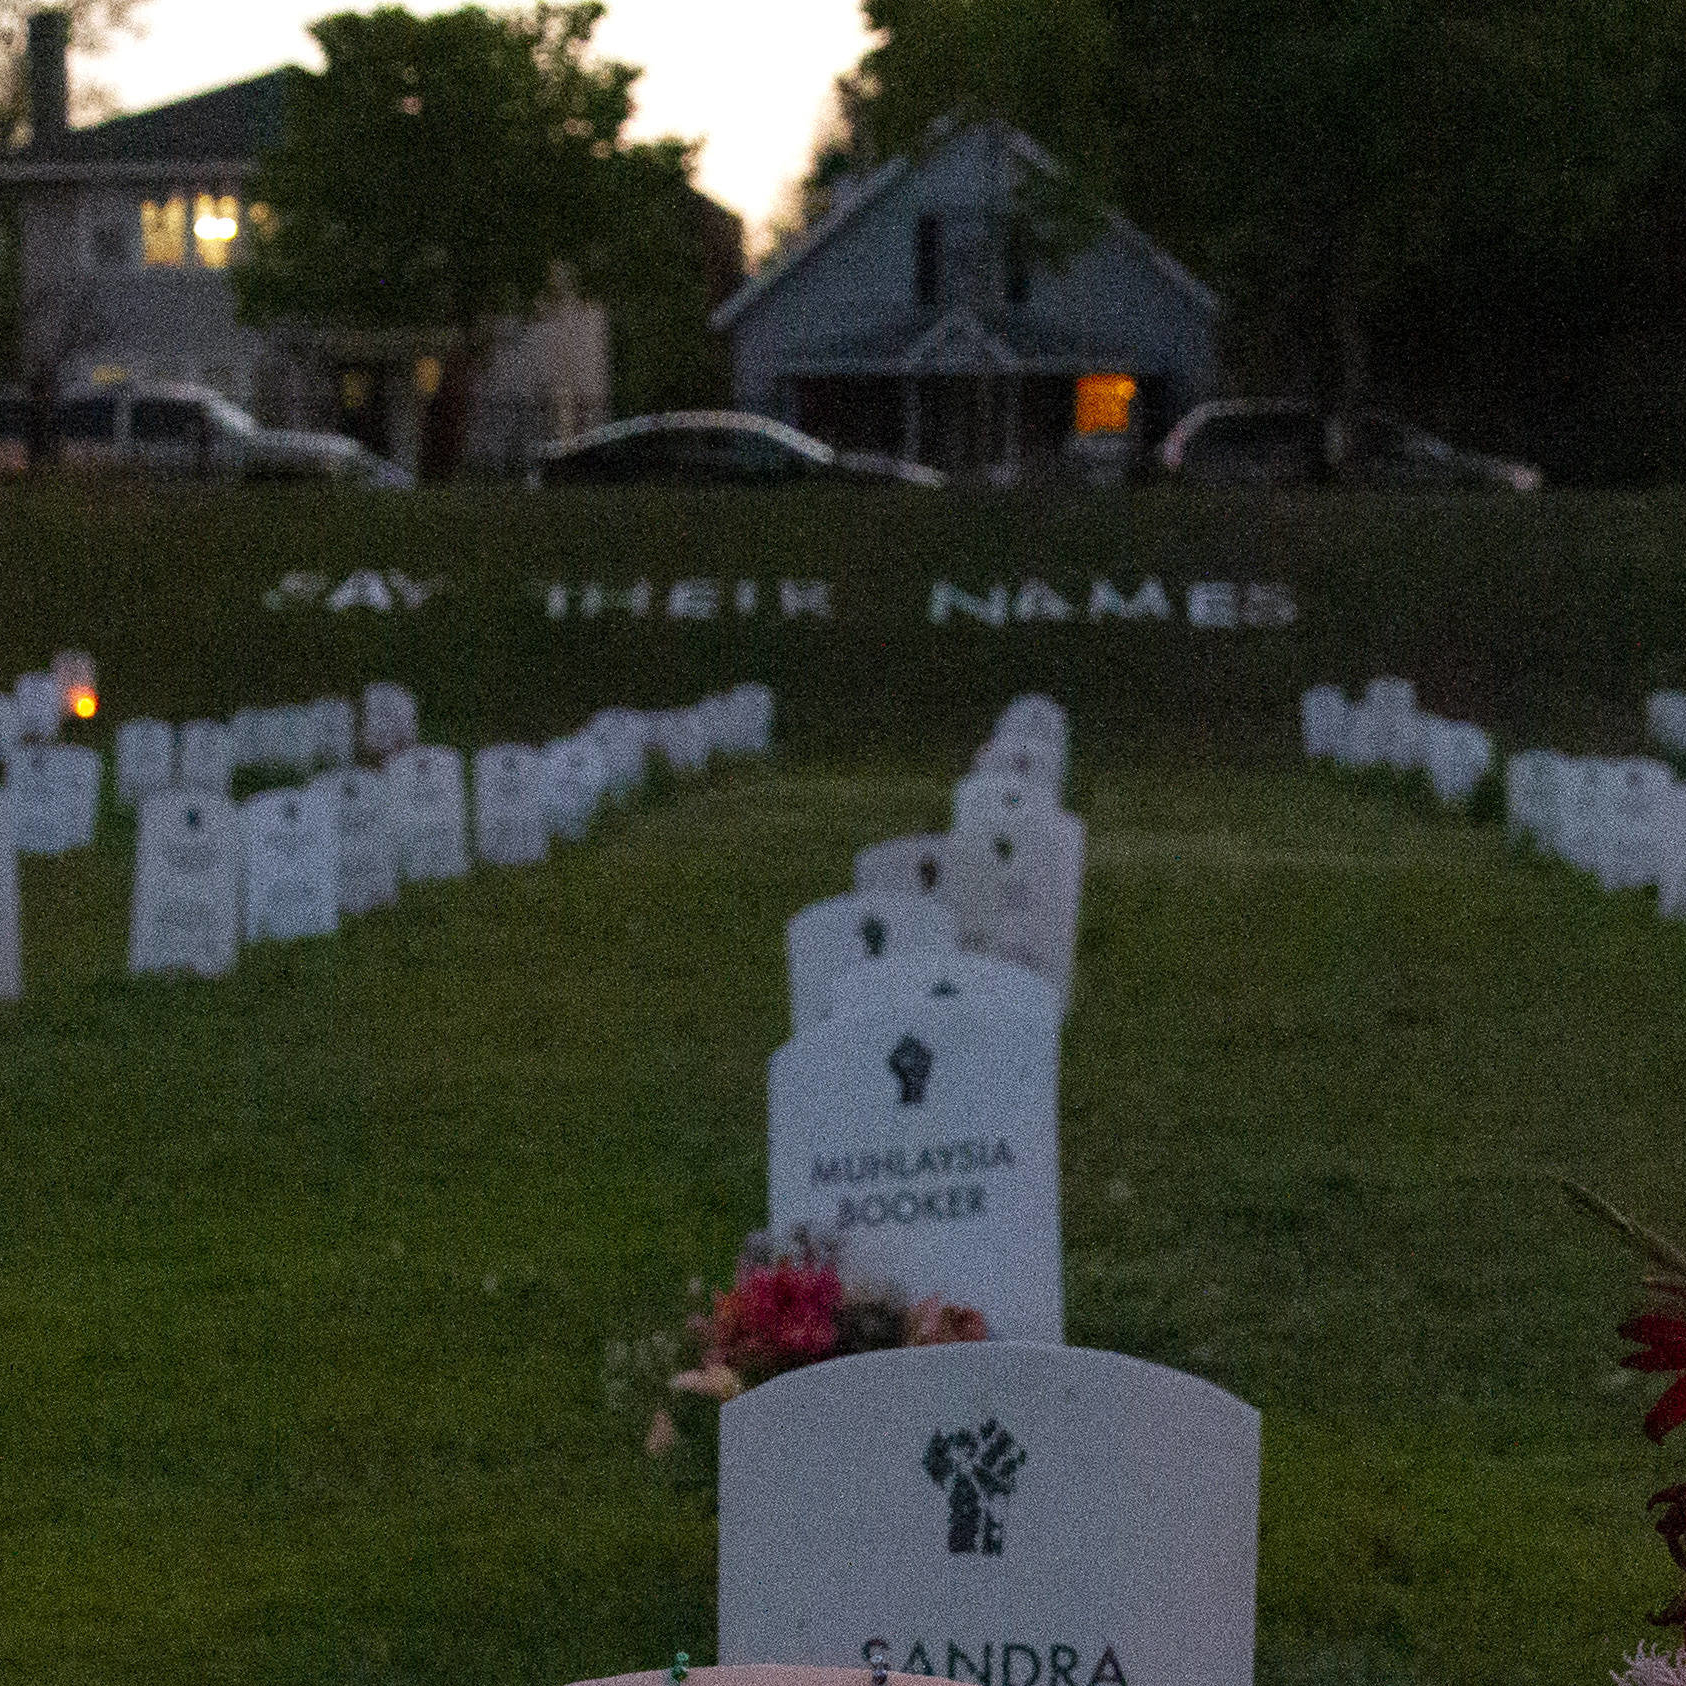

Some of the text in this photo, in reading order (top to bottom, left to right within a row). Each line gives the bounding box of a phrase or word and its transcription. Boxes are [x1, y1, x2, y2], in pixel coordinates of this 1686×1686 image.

[926, 574, 1299, 628] NAMES
[811, 1138, 1016, 1186] MUHLAYSIA
[836, 1186, 986, 1230] BOOKER
